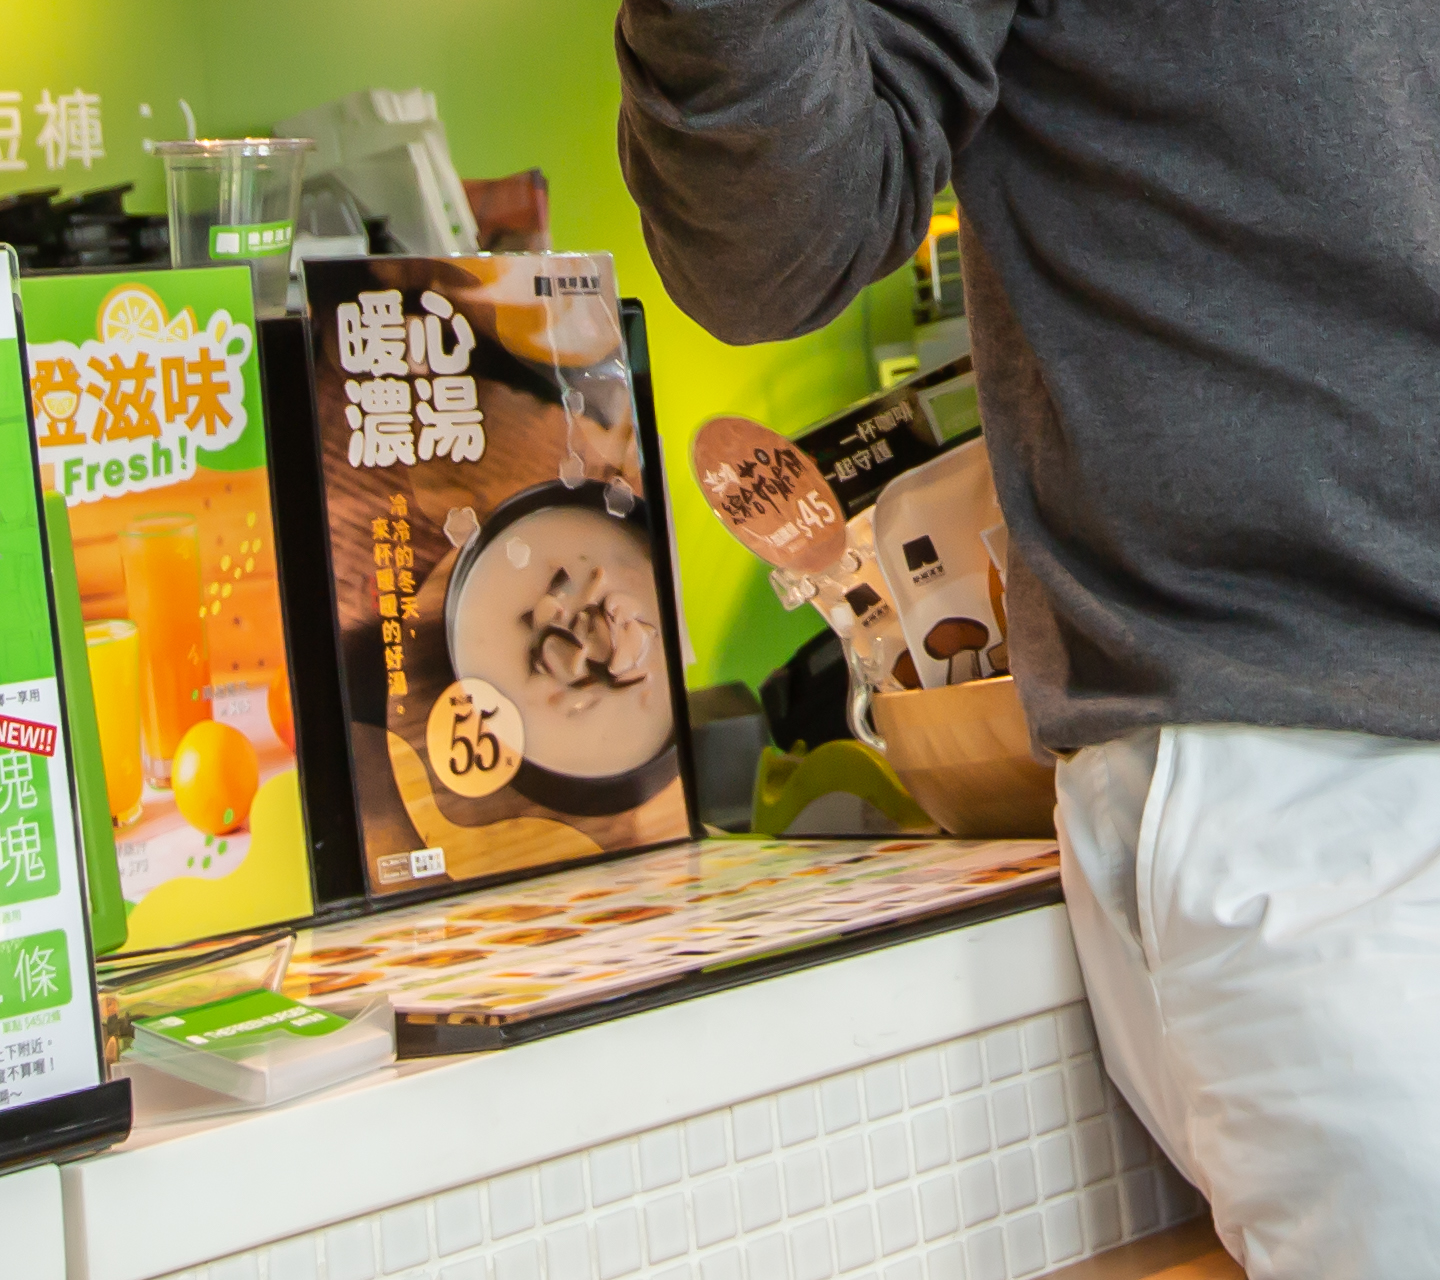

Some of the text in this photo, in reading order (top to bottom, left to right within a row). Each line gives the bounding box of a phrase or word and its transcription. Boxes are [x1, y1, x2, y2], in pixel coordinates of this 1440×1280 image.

[337, 288, 475, 377] 暖心
[30, 345, 235, 448] 橙滋味
[344, 375, 486, 468] 濃湯
[63, 436, 190, 498] Fresh!
[449, 706, 500, 776] 55
[13, 945, 59, 1001] 條
